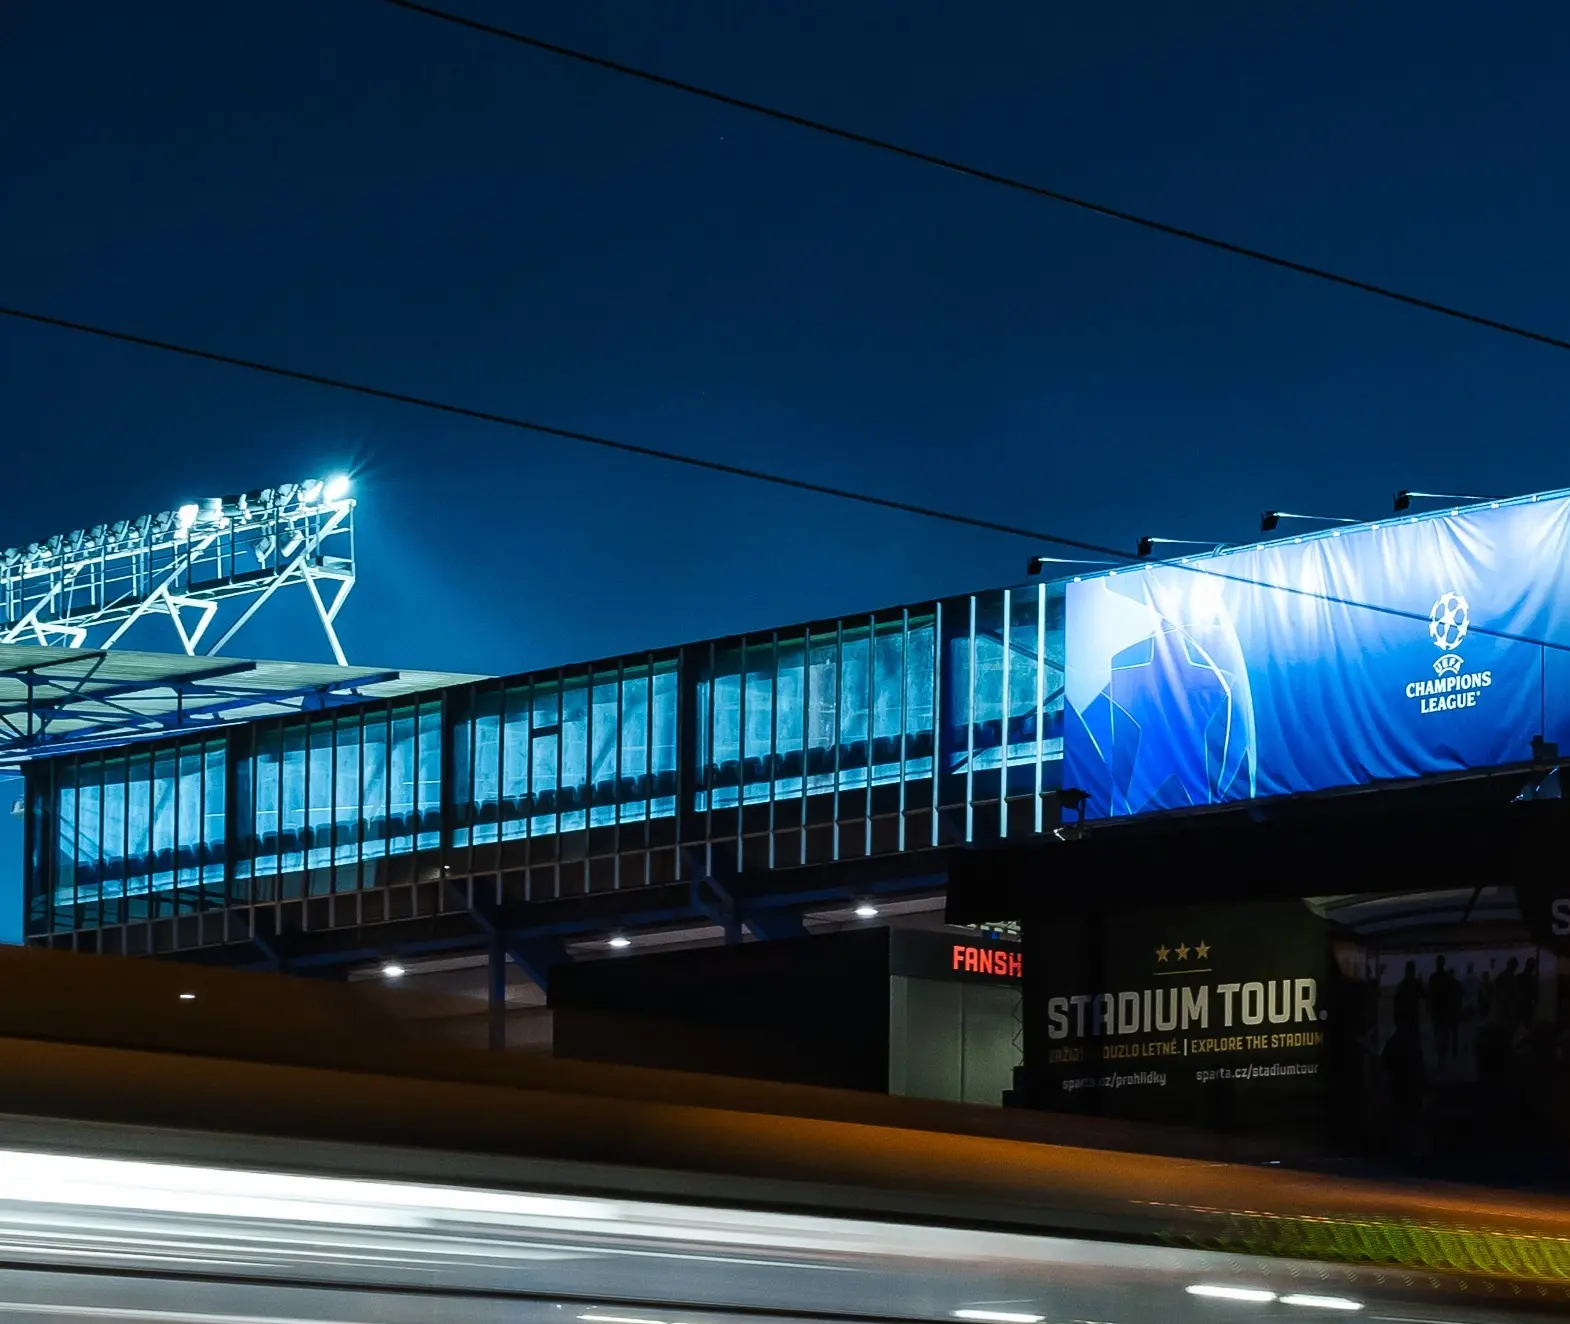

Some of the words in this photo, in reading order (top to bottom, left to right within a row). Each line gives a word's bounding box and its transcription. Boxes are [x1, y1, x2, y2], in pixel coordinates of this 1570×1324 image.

[1405, 670, 1492, 698] CHAMPIONS
[1047, 985, 1209, 1040] STADIUM
[1216, 977, 1329, 1027] TOUR.
[1191, 1037, 1243, 1054] EXPLORE
[1246, 1034, 1268, 1050] THE
[1271, 1031, 1324, 1049] STADIUM
[1196, 1063, 1320, 1084] sparta.cz/stadiumtour
